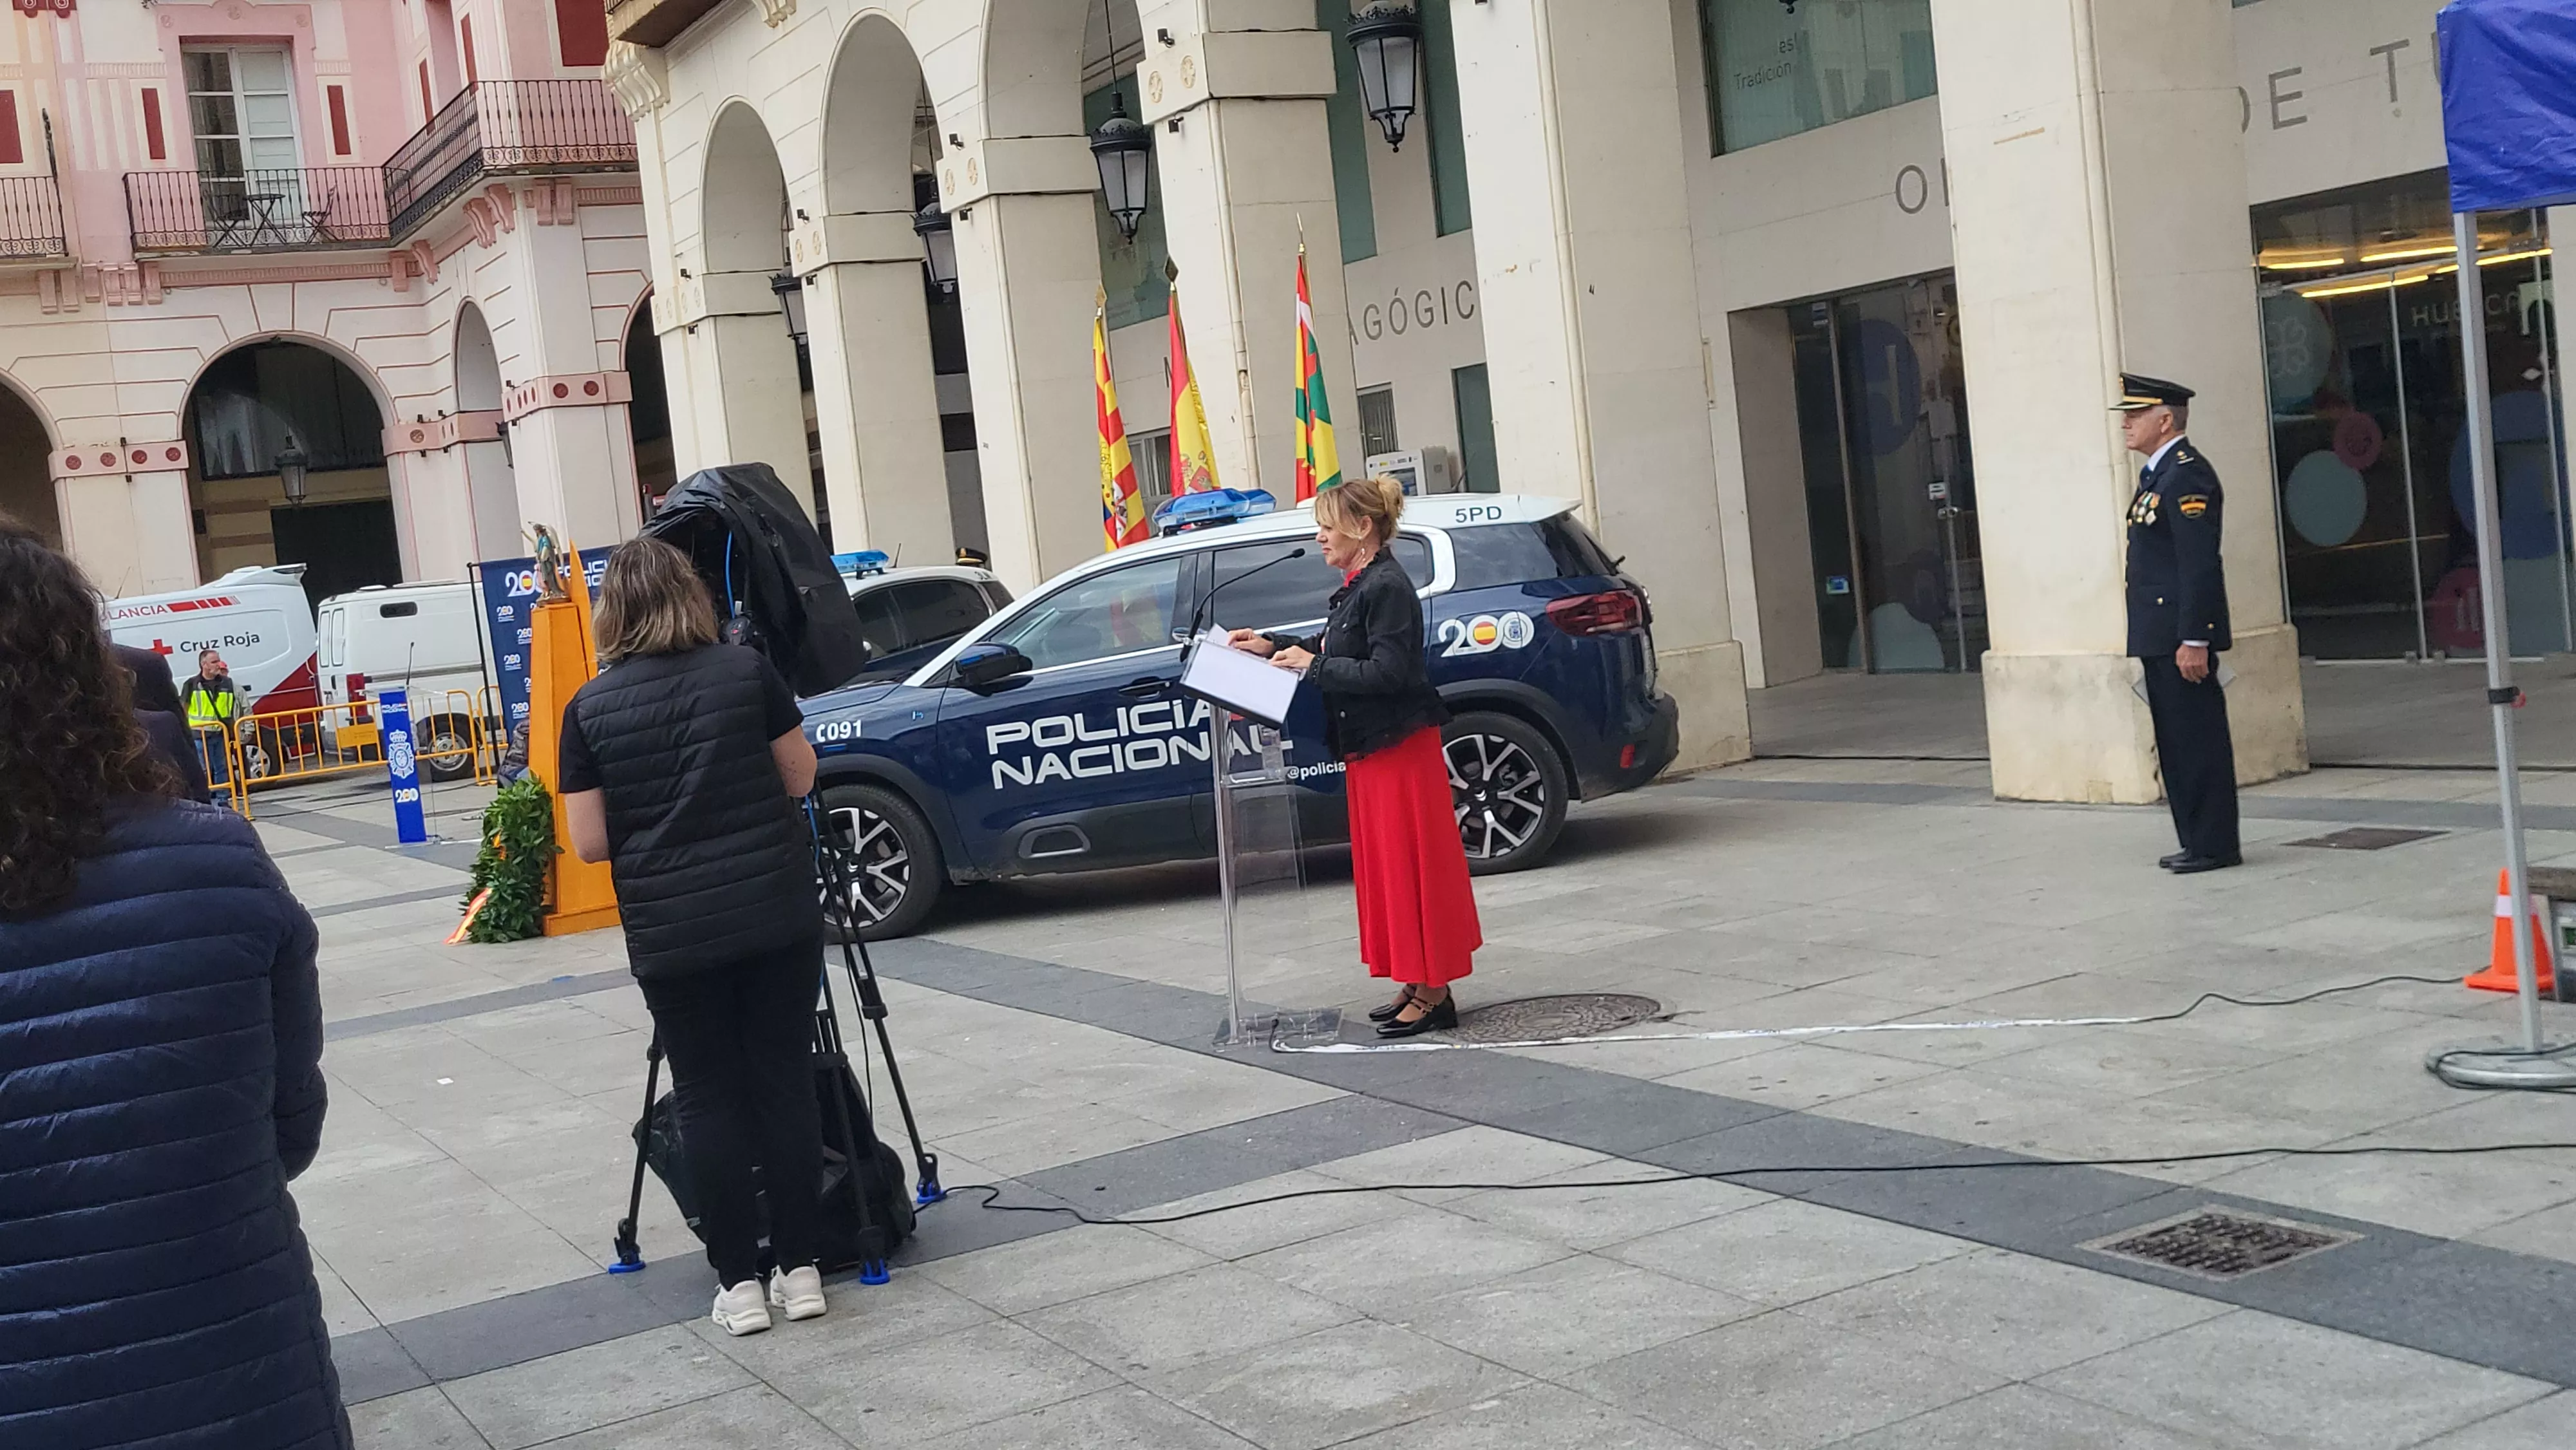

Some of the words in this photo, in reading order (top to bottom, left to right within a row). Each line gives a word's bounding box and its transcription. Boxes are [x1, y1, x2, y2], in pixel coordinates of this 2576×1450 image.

[1455, 506, 1502, 523] 5PD
[180, 639, 220, 653] Cruz
[223, 631, 261, 648] Roja
[1437, 611, 1535, 658] 200
[395, 787, 419, 803] 200
